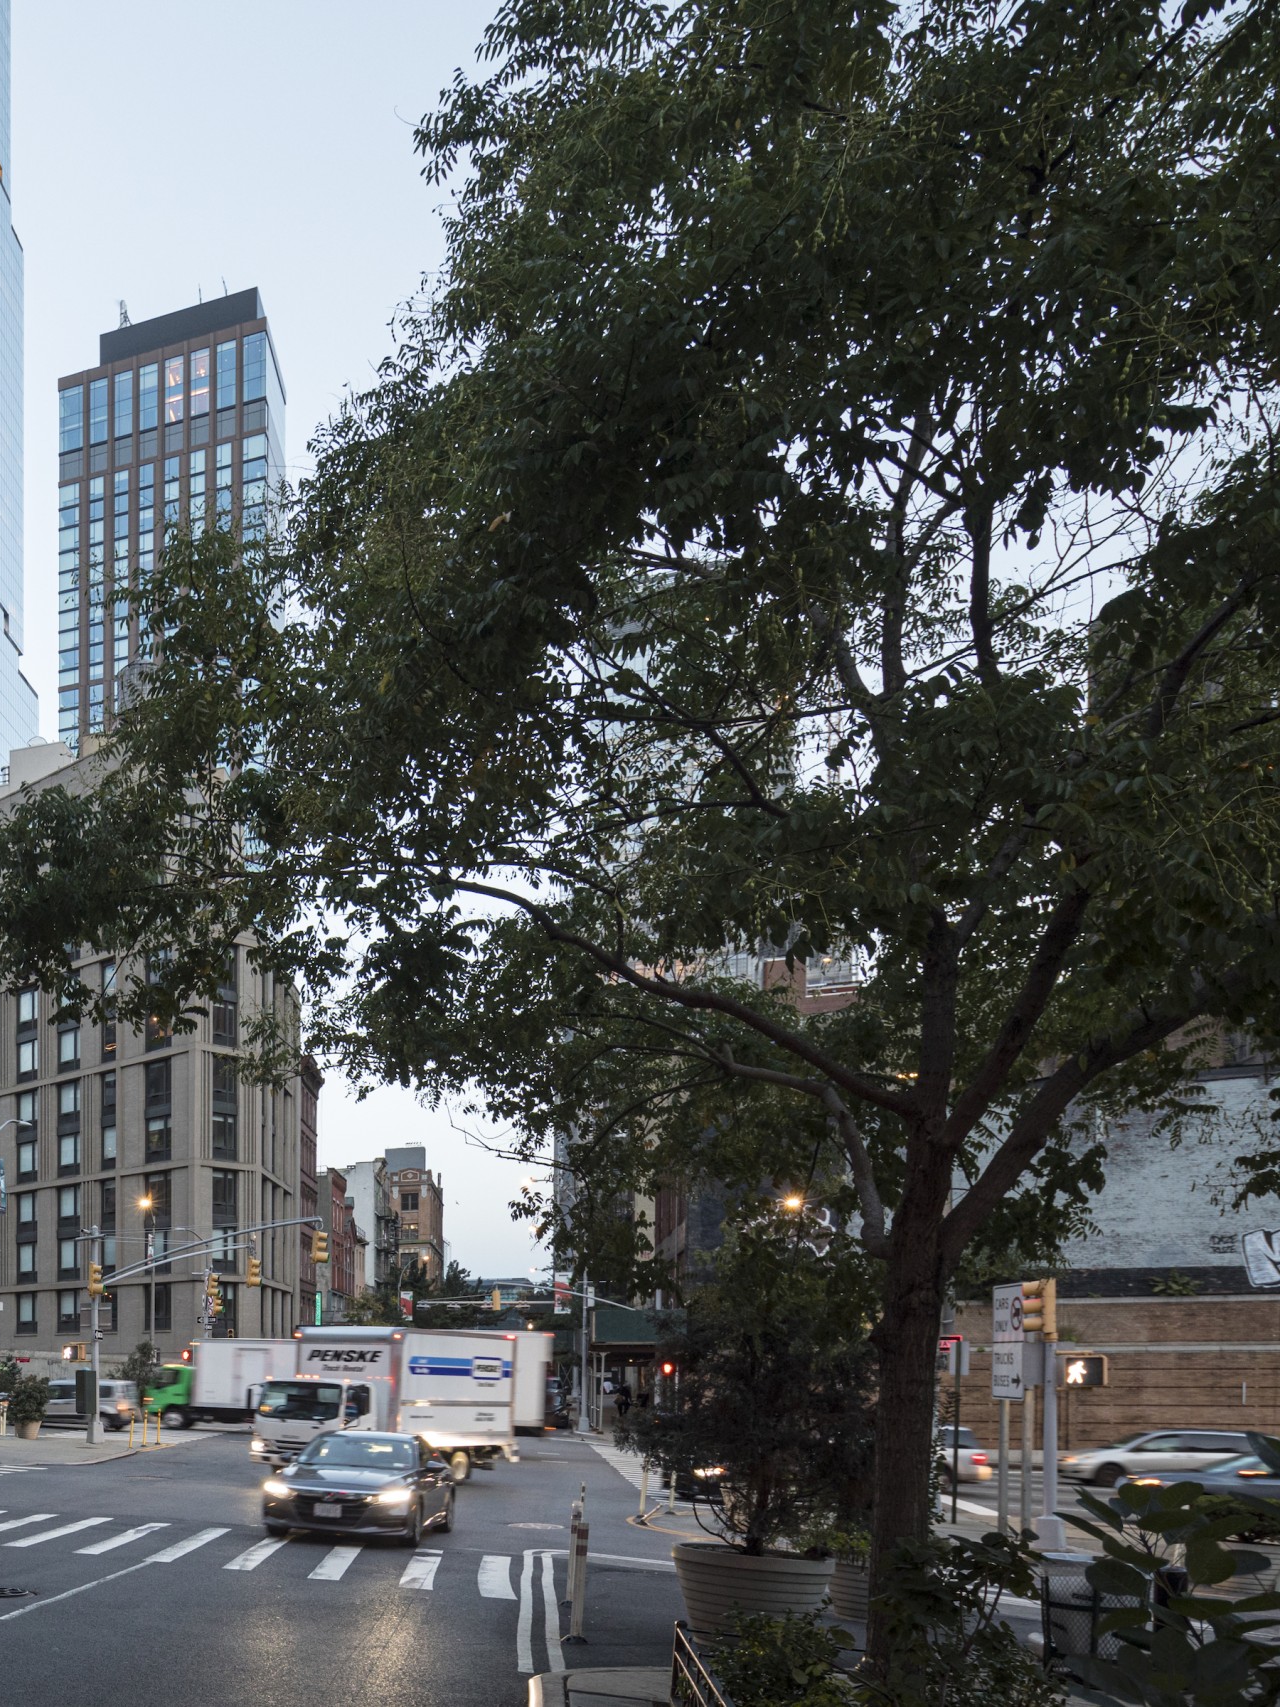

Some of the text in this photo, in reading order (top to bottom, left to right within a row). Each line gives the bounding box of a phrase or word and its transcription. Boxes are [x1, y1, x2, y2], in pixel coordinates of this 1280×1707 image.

[995, 1298, 1009, 1310] CARS
[995, 1321, 1008, 1332] ONLY
[307, 1350, 384, 1362] PENSKE
[994, 1352, 1014, 1365] TRUCKS
[993, 1375, 1010, 1387] BUSES
